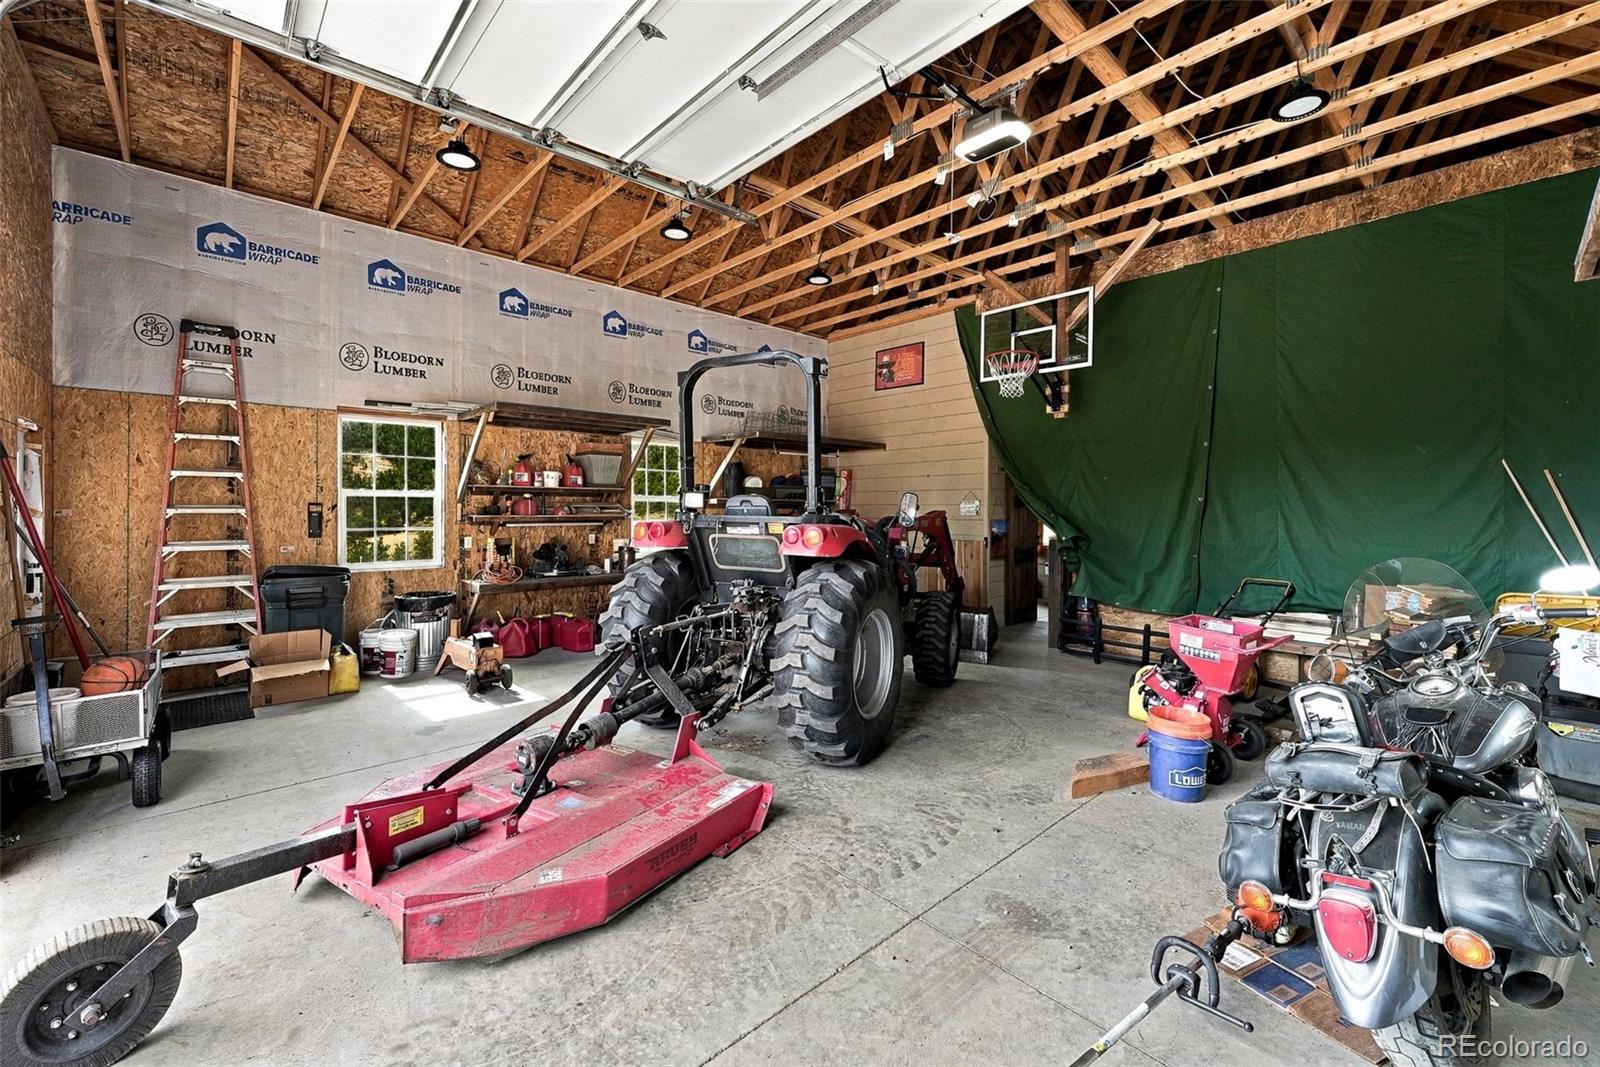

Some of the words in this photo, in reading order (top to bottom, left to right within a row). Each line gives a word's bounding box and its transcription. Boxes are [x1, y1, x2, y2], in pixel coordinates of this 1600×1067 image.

[52, 200, 132, 226] ARRICADE
[52, 211, 83, 225] RAP
[248, 241, 319, 265] BARRICADE
[248, 251, 283, 265] WRAP
[406, 275, 462, 294] BARRICADE
[407, 284, 433, 295] WRAP
[529, 301, 573, 318] BARRICADE
[529, 309, 550, 319] WRAP
[373, 345, 444, 367] BLOEDORN
[373, 360, 427, 379] LUMBER
[517, 366, 572, 384] BLOEDORN
[517, 380, 559, 396] LUMBER
[628, 383, 672, 398] BLOEDORN
[628, 395, 662, 408] LUMBER
[717, 396, 753, 409] BLOEDORN
